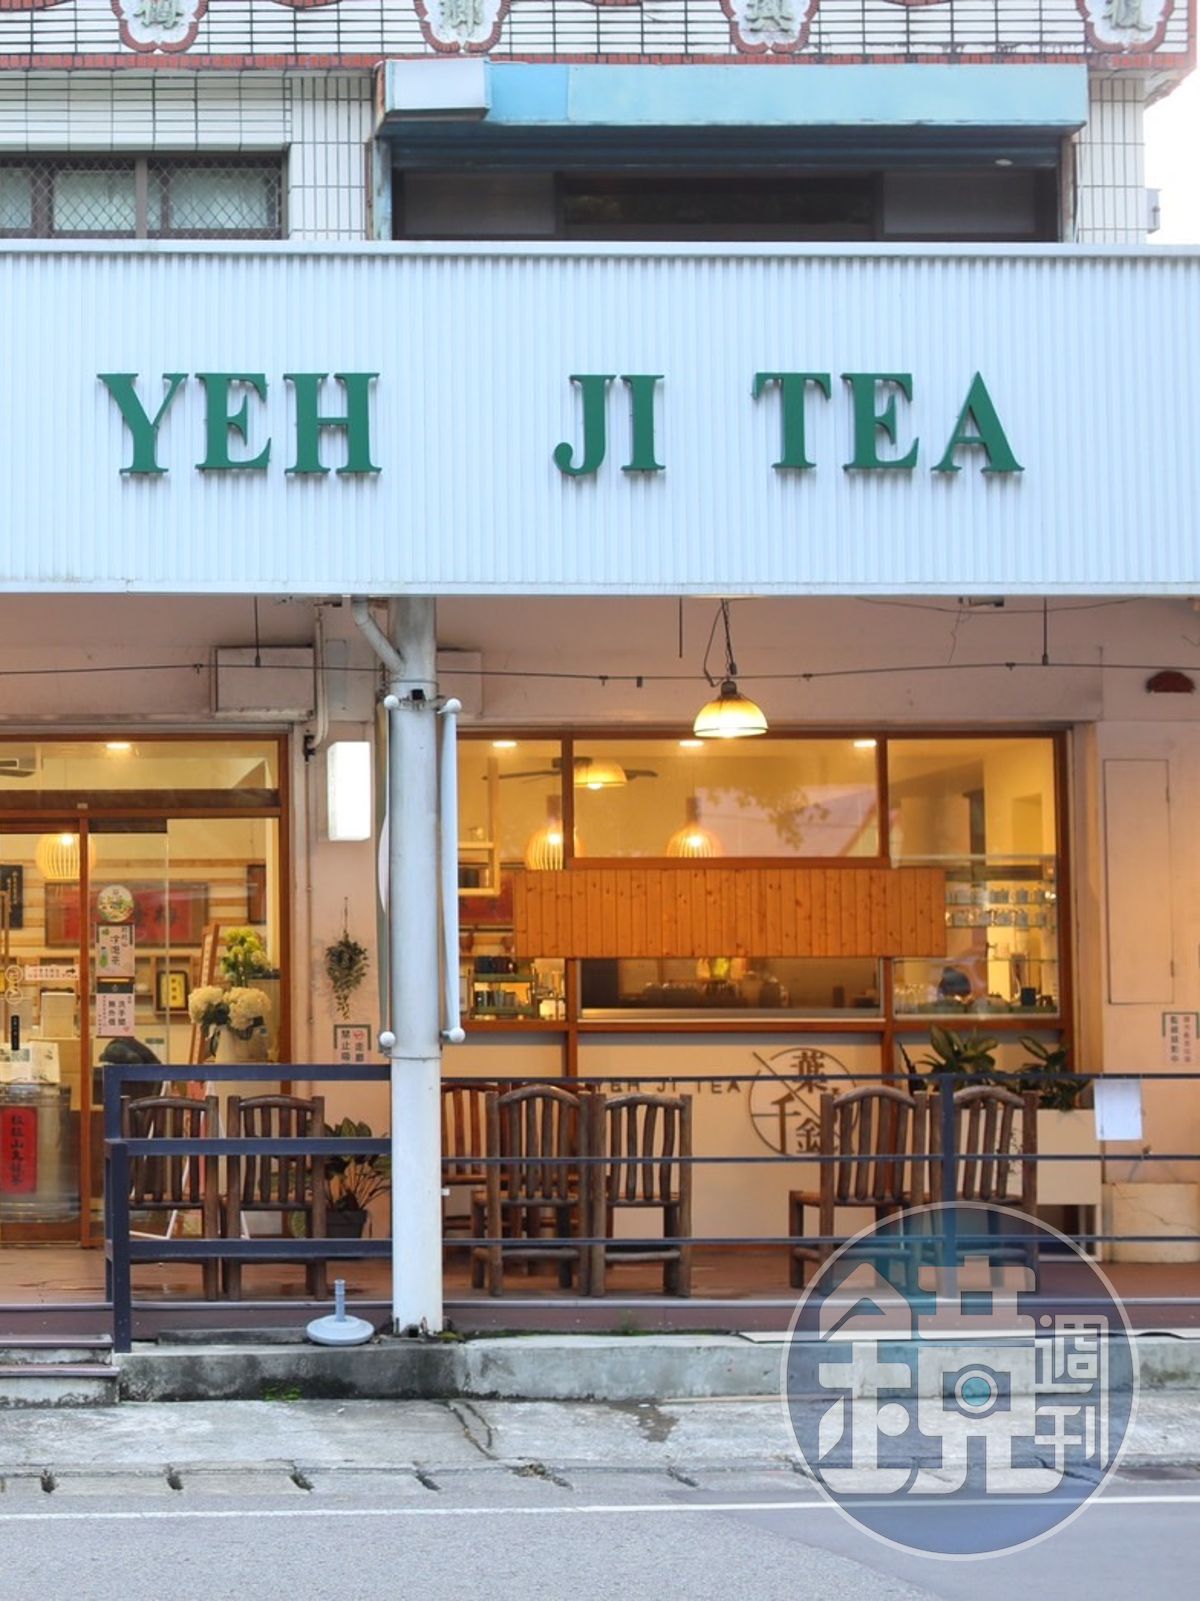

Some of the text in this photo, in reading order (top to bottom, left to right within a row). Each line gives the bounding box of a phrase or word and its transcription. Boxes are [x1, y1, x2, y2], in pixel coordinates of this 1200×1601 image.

[96, 370, 1026, 477] YEH JI TEA
